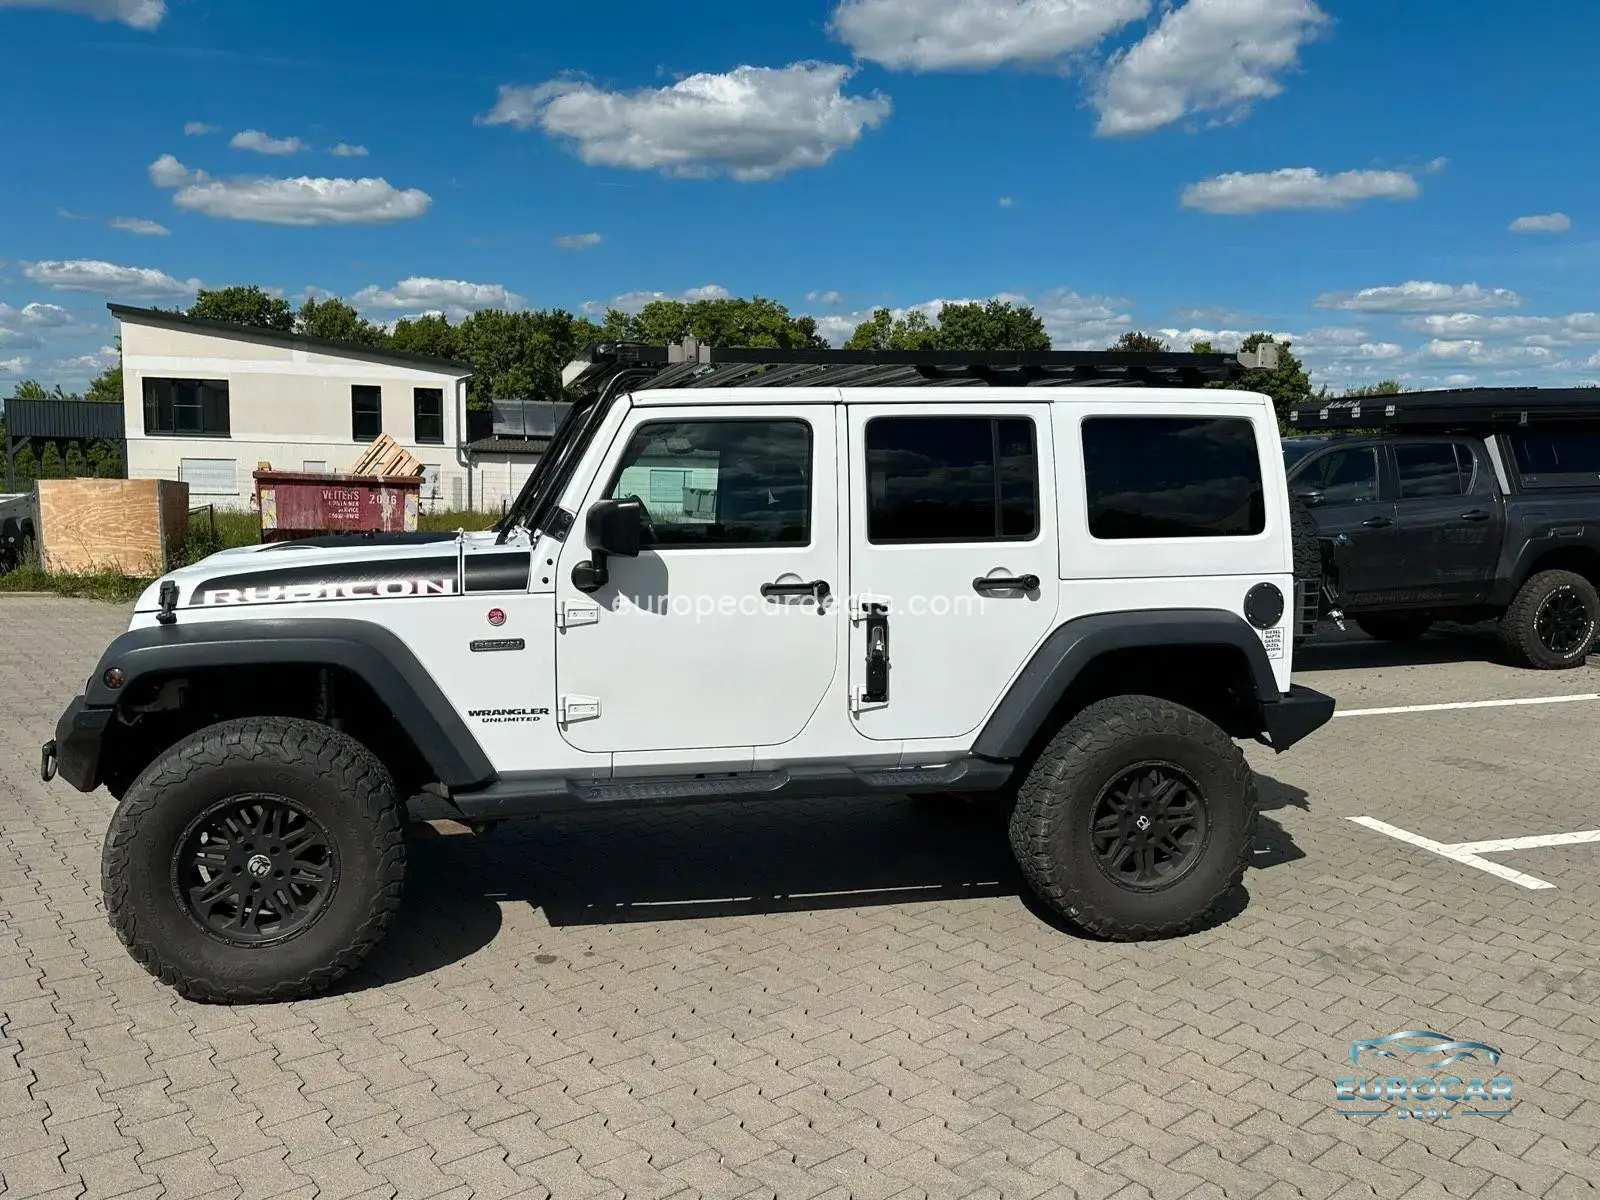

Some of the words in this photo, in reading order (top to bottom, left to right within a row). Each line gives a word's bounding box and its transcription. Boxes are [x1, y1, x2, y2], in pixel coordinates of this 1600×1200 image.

[203, 578, 454, 605] RUBICON
[467, 707, 550, 717] WRANGLER
[482, 716, 541, 724] UNLIMITED
